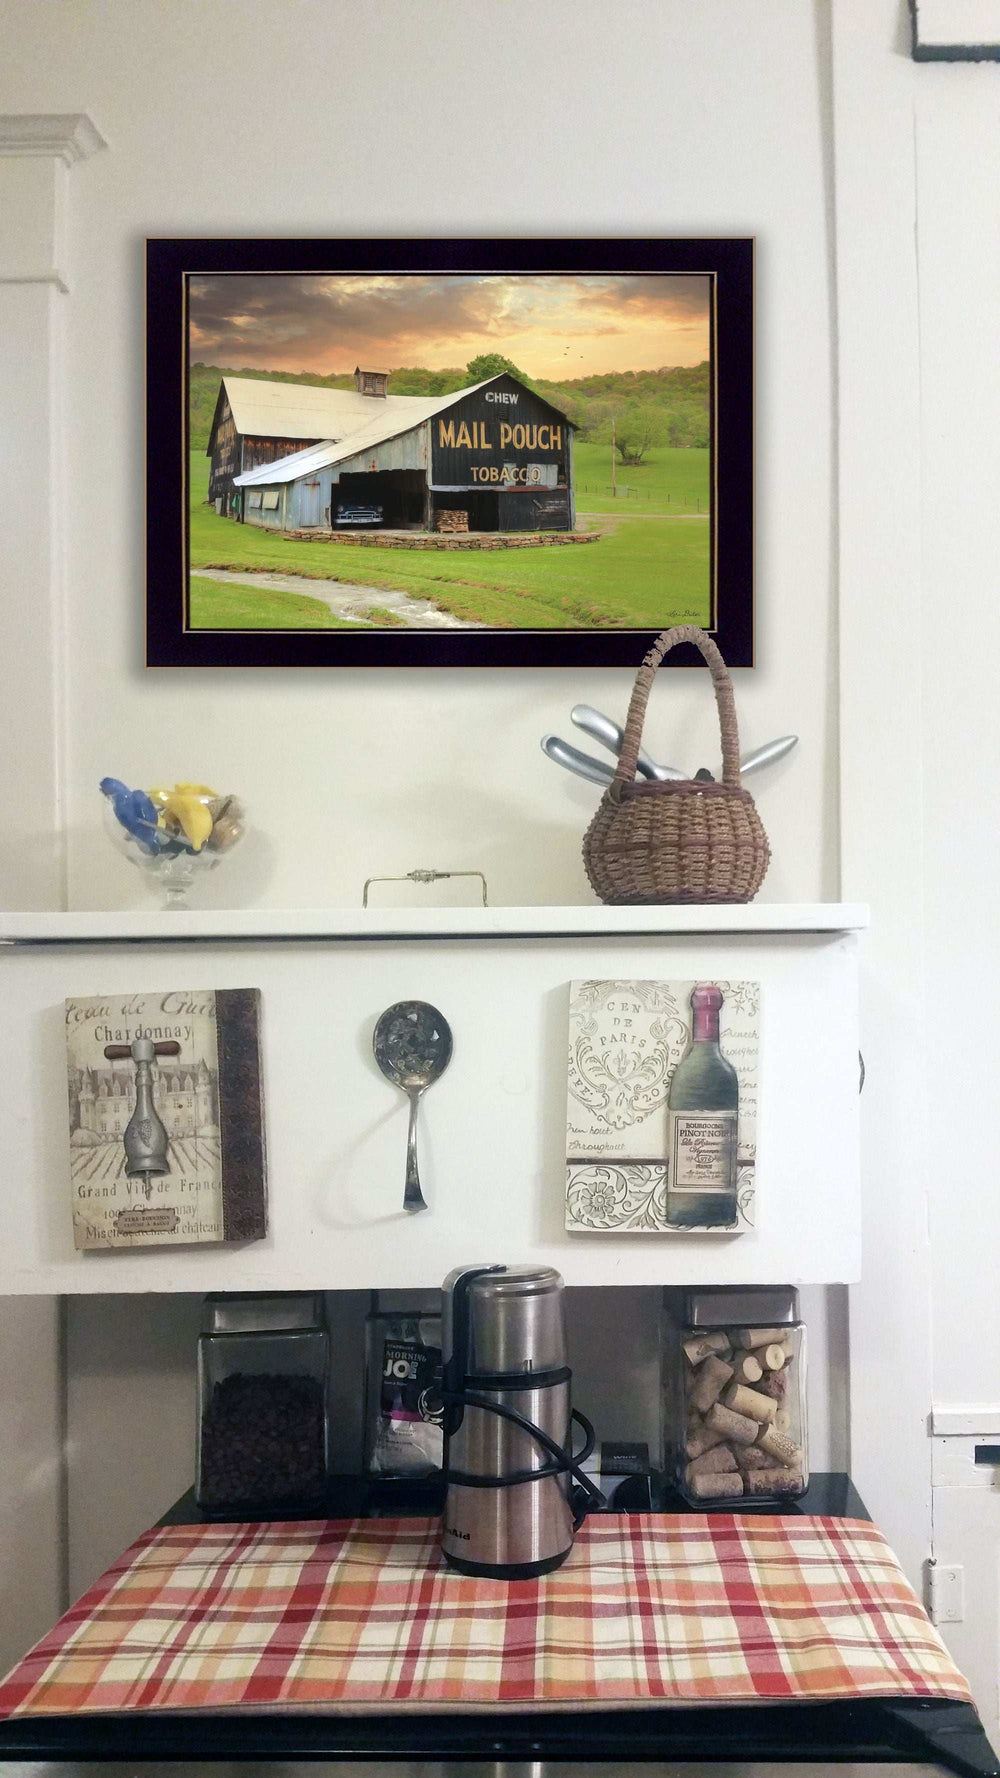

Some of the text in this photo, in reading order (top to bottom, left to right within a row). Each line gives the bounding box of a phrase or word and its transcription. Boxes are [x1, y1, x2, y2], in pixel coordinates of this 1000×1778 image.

[485, 391, 519, 404] CHEW
[439, 419, 562, 450] MAIL POUCH
[470, 466, 541, 482] TOBACCO
[613, 1018, 633, 1027] DE
[94, 1021, 193, 1042] Chardonnay
[600, 1033, 647, 1048] PARIS
[679, 1129, 706, 1137] PINOT
[78, 1184, 117, 1198] Grand
[157, 1180, 171, 1193] de
[385, 1350, 427, 1362] MORNING
[383, 1359, 419, 1380] JOE
